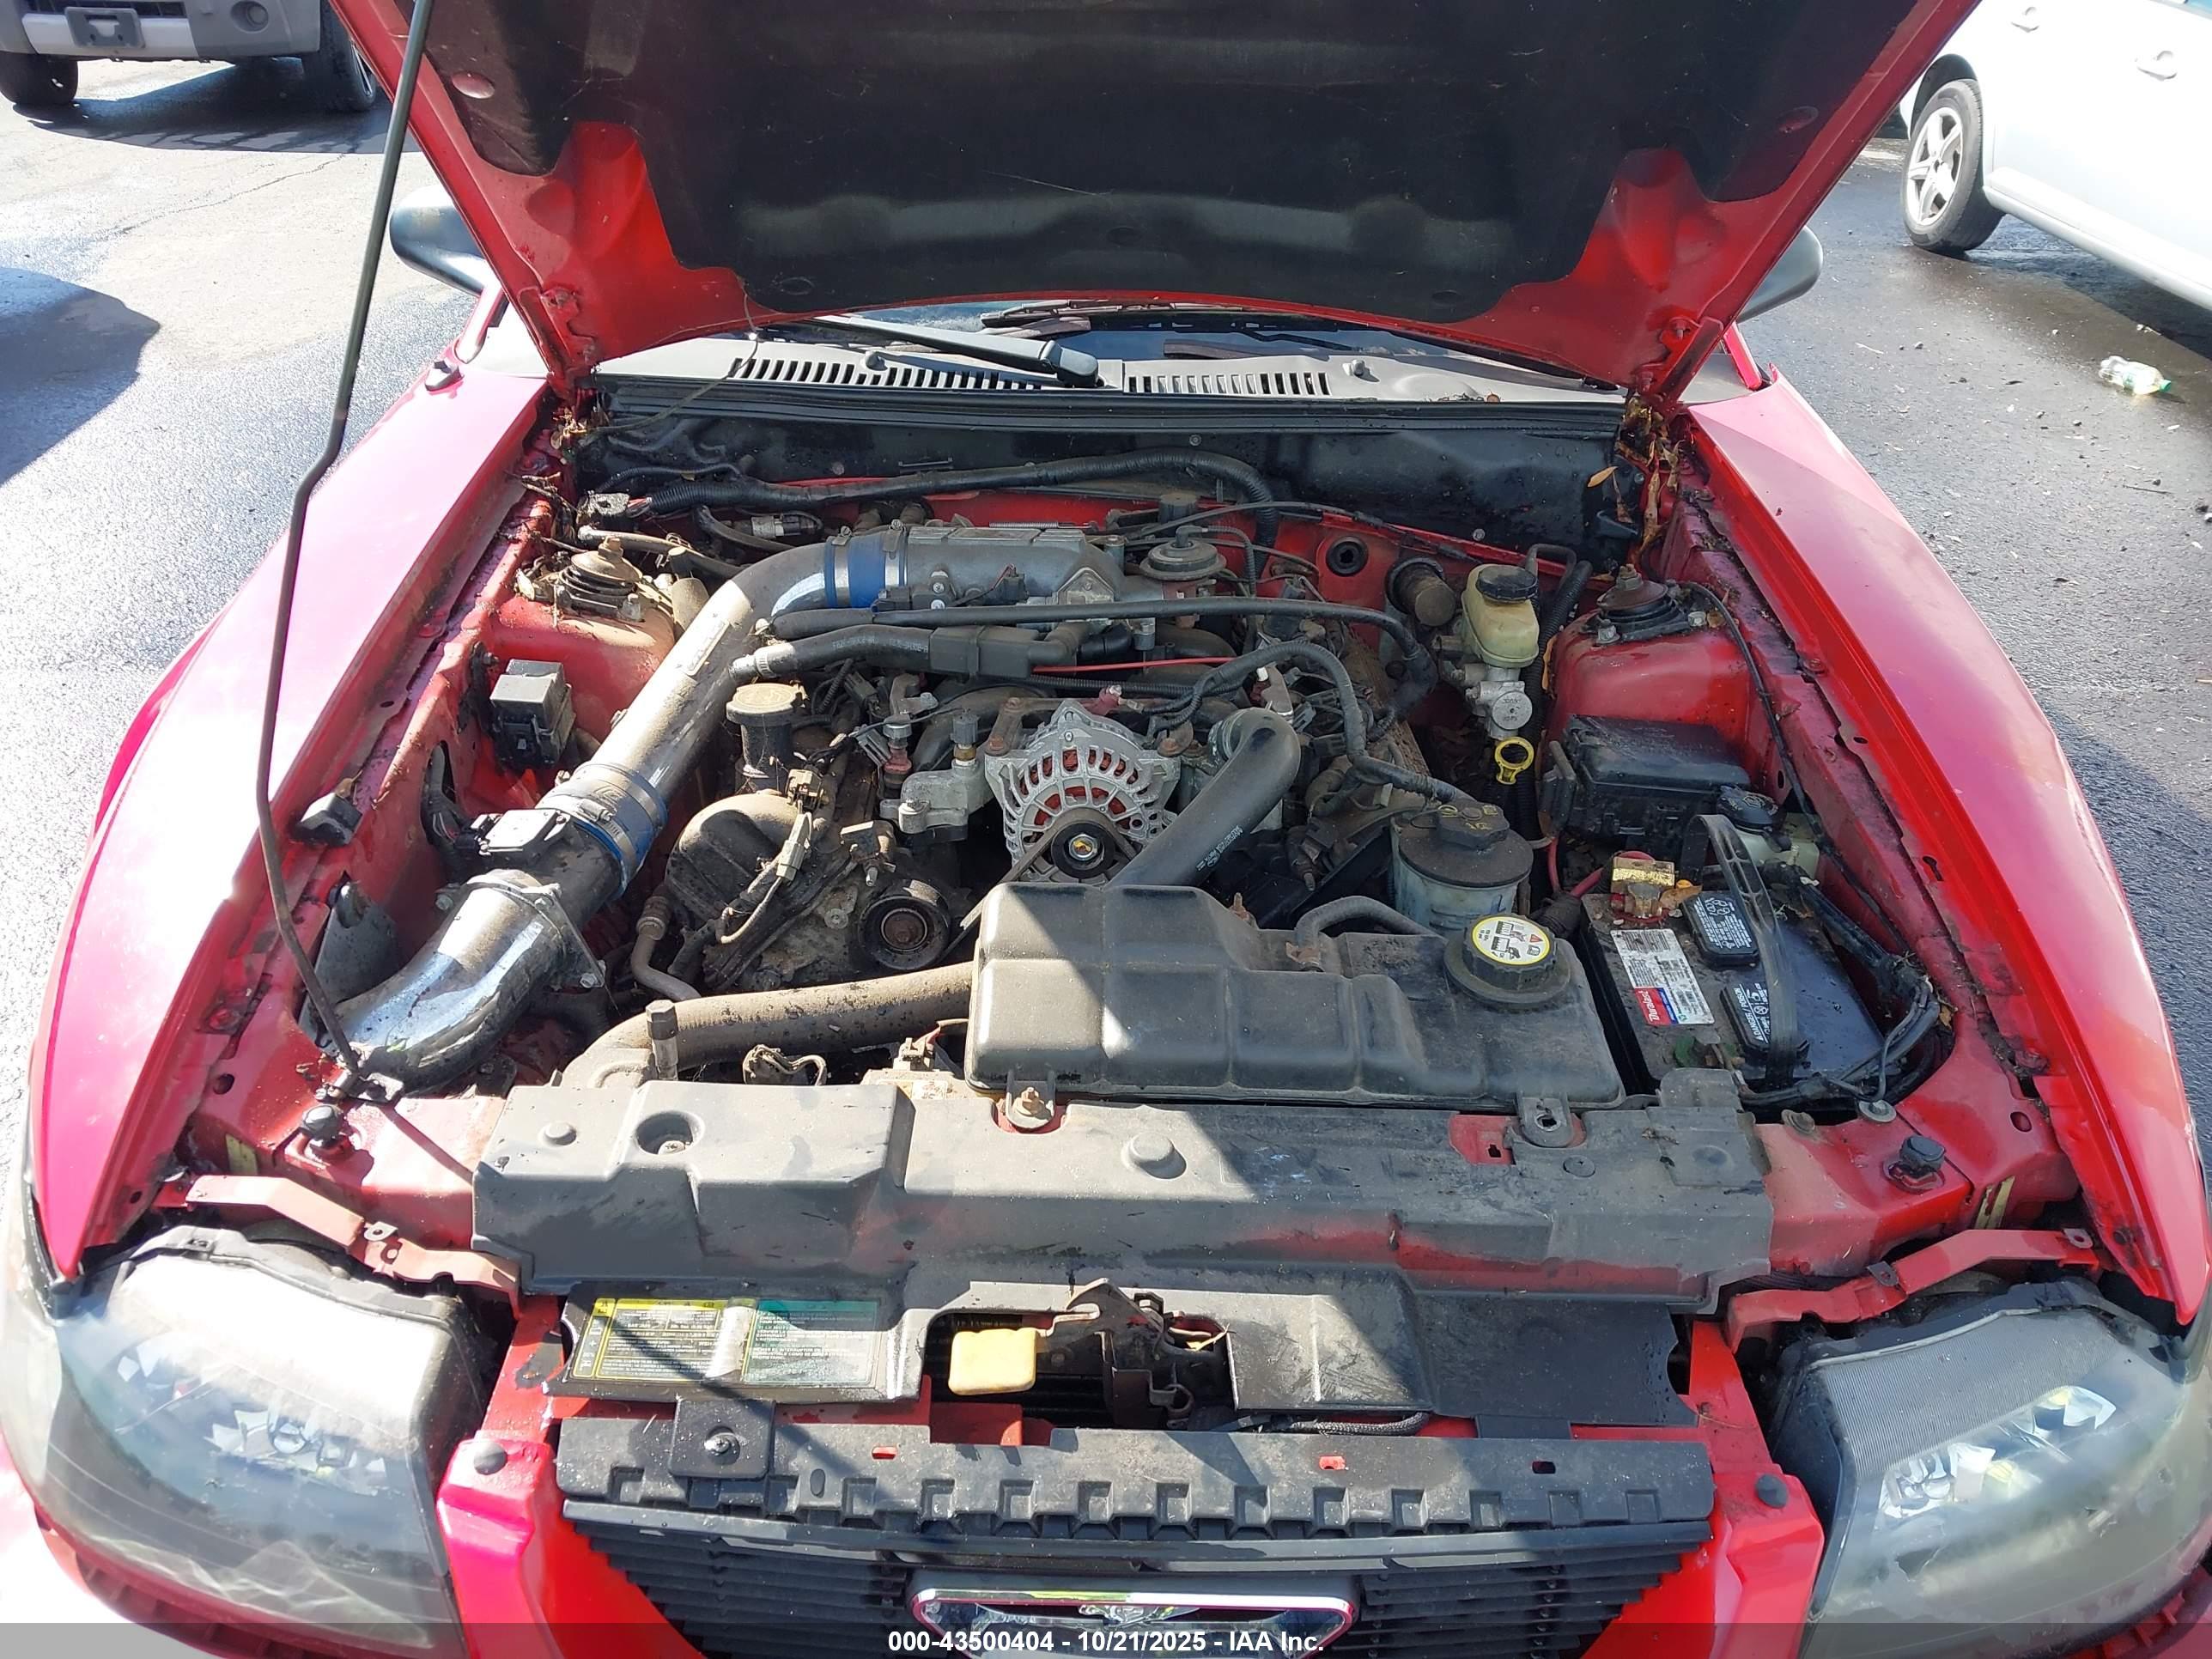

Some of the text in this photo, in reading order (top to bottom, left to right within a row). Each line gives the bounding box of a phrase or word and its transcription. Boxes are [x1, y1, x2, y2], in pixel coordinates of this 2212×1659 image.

[1638, 989, 1660, 1023] Duralast
[1733, 988, 1748, 1008] POISON
[1744, 1012, 1761, 1036] DANGER
